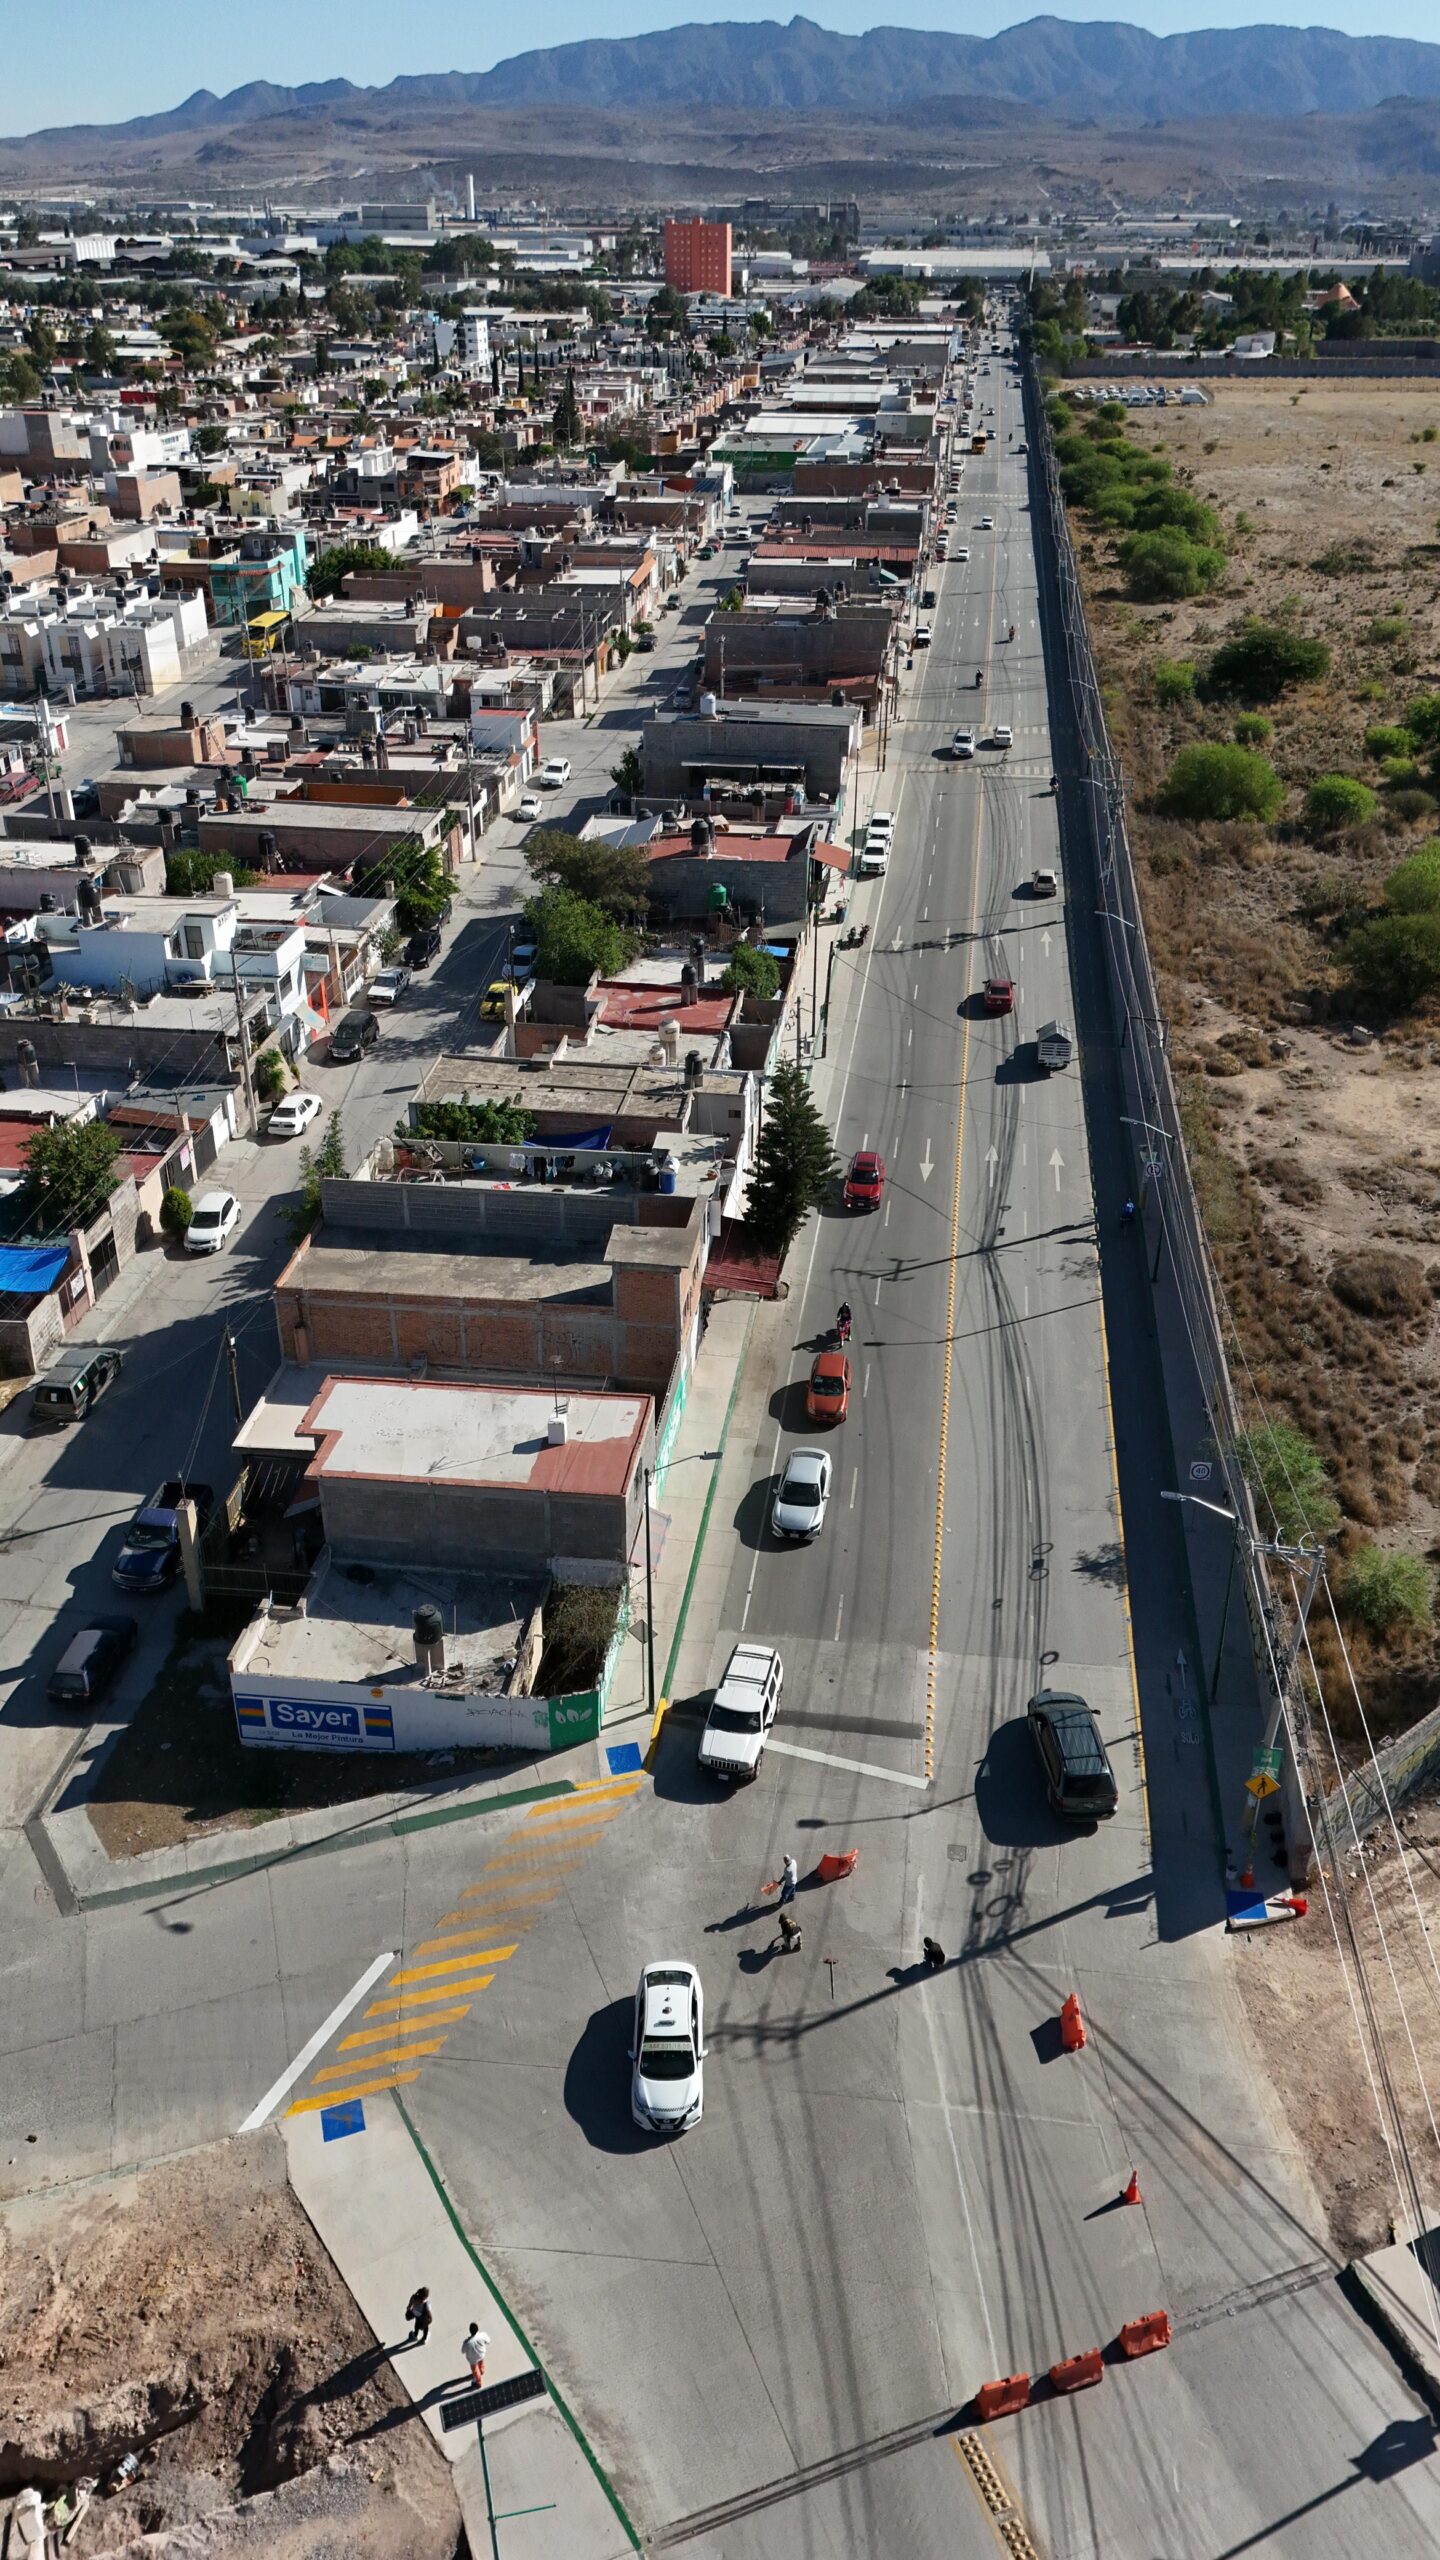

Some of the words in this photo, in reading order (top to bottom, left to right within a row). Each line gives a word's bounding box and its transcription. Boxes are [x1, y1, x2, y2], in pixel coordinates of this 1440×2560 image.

[276, 1703, 352, 1729] Sayer
[292, 1731, 303, 1739] La
[305, 1732, 330, 1742] Mejor
[332, 1734, 364, 1744] Pintura
